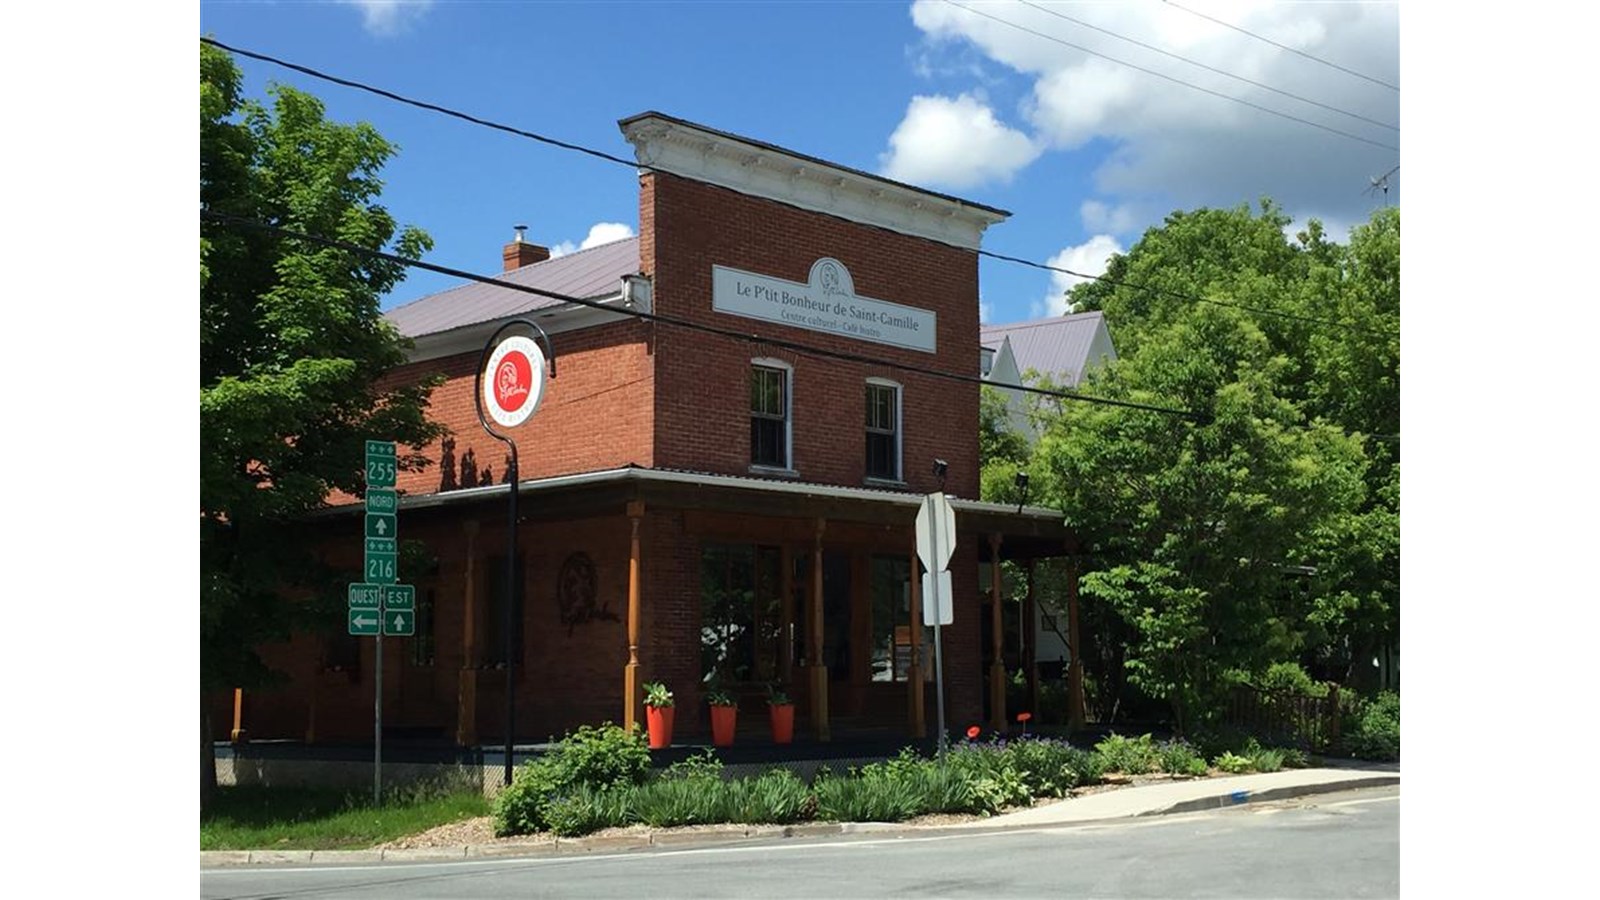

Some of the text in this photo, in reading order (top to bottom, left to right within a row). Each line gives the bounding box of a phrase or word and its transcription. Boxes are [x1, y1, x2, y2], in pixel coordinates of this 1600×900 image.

[737, 281, 751, 297] Le
[755, 285, 779, 303] P'tit
[781, 291, 831, 313] Bonheur
[834, 302, 847, 316] de
[849, 305, 919, 332] Saint-Camille
[781, 309, 806, 323] Centre
[369, 461, 394, 481] 255
[369, 495, 393, 508] NORD
[369, 559, 393, 578] 216
[351, 588, 378, 604] OUEST
[388, 591, 409, 604] EST
